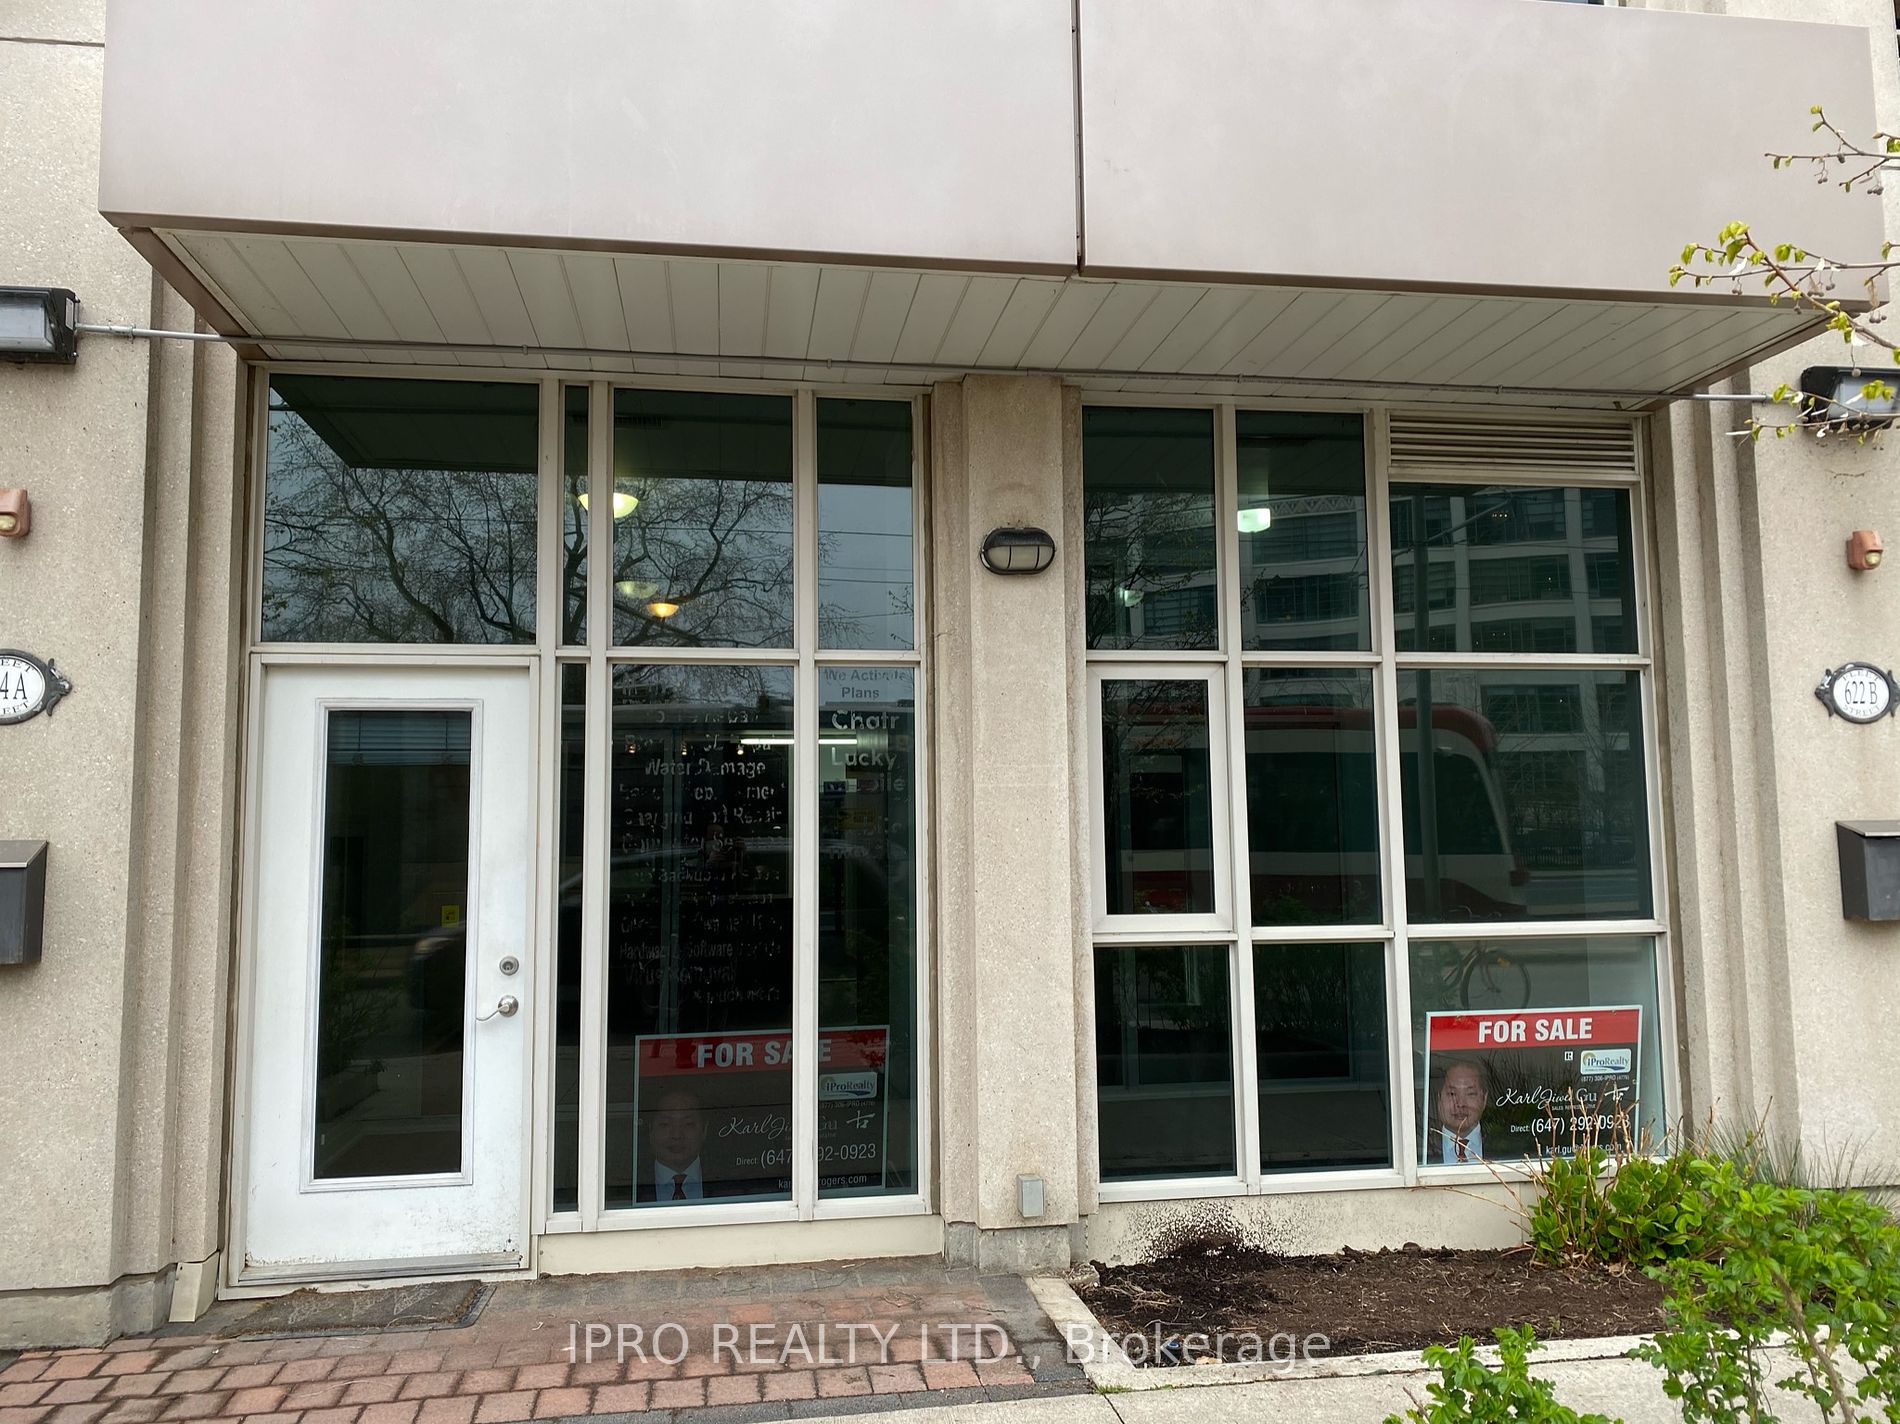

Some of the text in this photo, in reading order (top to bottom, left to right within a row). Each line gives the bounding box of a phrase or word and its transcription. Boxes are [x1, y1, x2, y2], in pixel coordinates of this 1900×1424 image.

[825, 669, 846, 681] We
[841, 686, 880, 699] Plans
[645, 758, 767, 779] Water Dmage
[831, 746, 898, 771] Lucky
[1478, 1017, 1593, 1044] FOR SALE
[697, 1038, 832, 1069] FOR SAE
[1495, 1085, 1542, 1107] Karl
[1576, 1088, 1597, 1102] Gu
[718, 1113, 773, 1138] Karl
[1531, 1117, 1565, 1137] (647)
[760, 1148, 793, 1169] (647
[818, 1143, 876, 1162] 92-0923
